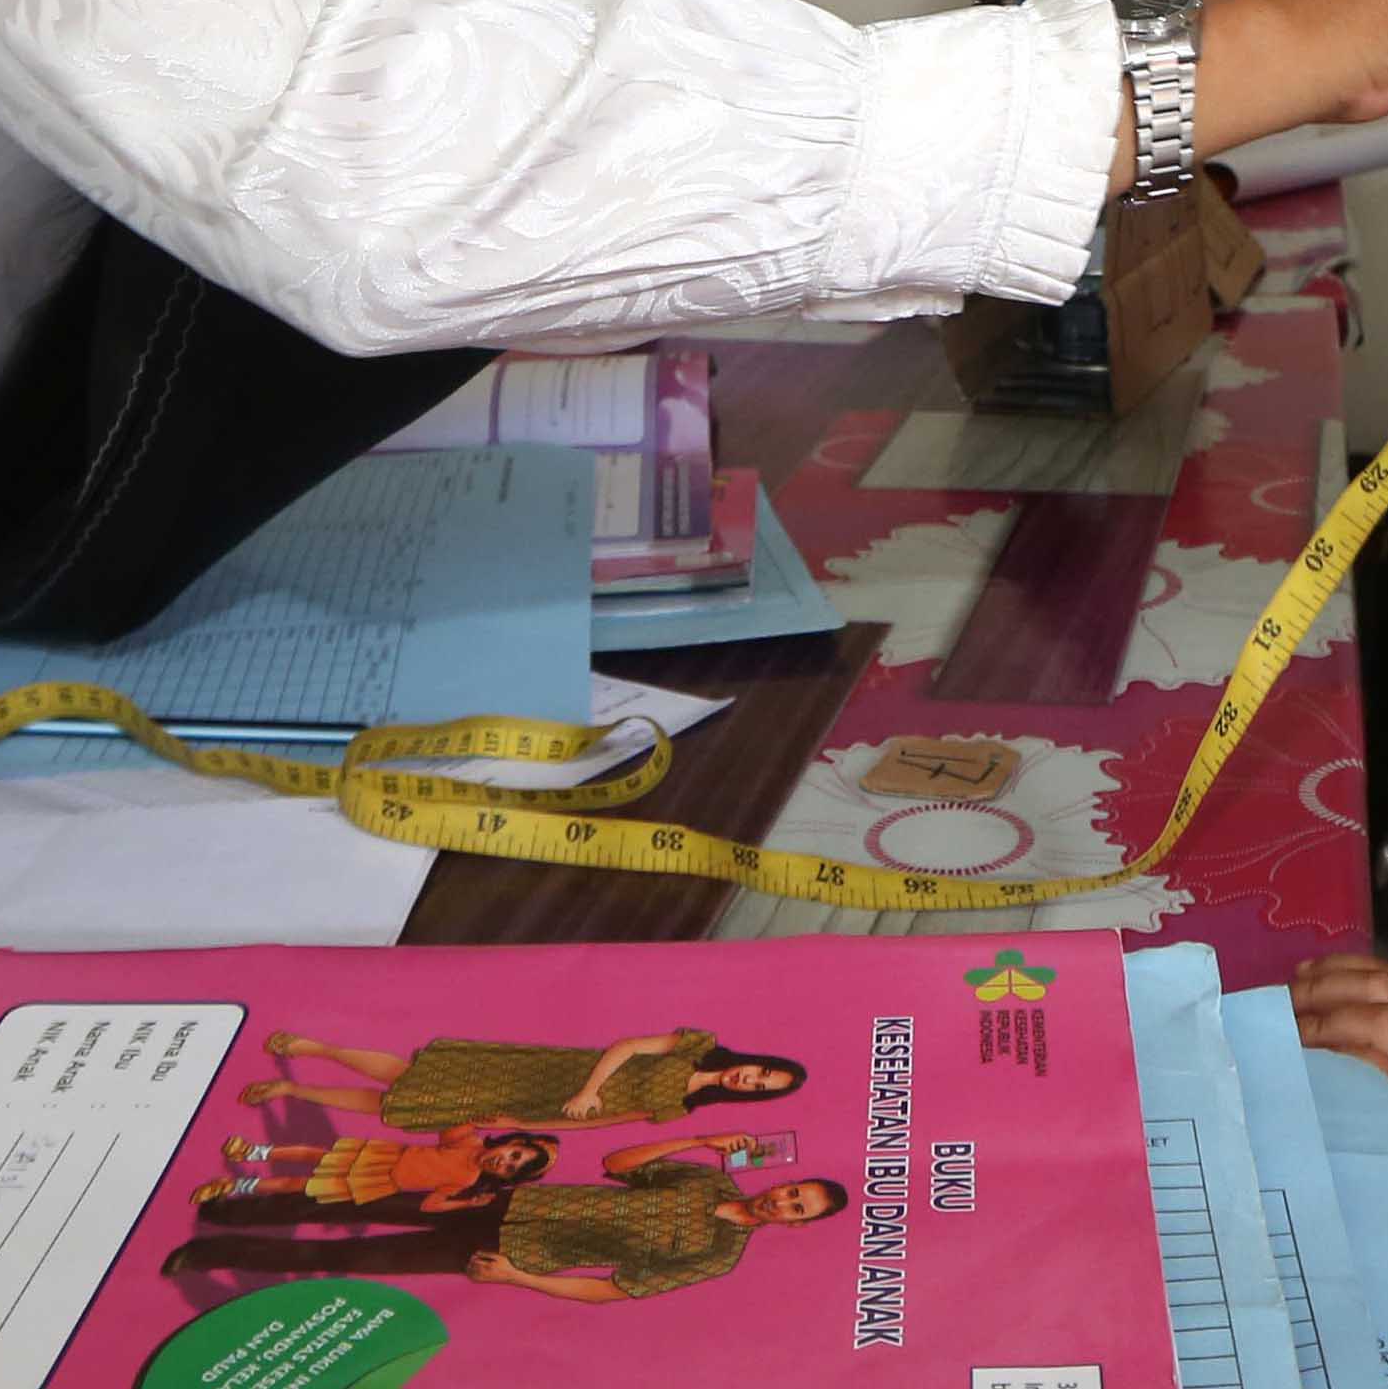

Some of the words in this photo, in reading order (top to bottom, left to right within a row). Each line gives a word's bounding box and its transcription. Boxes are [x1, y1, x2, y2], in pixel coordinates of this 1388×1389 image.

[1305, 536, 1335, 572] 30
[1253, 615, 1283, 653] 31
[1214, 698, 1240, 739] 32
[381, 798, 415, 823] 42
[474, 811, 508, 834] 41
[564, 820, 597, 843] 40
[651, 829, 685, 853] 39
[731, 844, 761, 873] 38
[815, 860, 846, 889] 37
[902, 876, 939, 896] 36
[37, 1020, 68, 1044] NIK
[73, 1020, 111, 1058] Nama
[128, 1020, 158, 1044] NIK
[163, 1020, 199, 1059] Nama
[12, 1046, 49, 1083] Anak
[114, 1048, 142, 1070] Ibu
[150, 1060, 178, 1082] Ibu
[51, 1060, 86, 1093] Anak
[867, 1015, 914, 1152] KESEHATAN
[863, 1155, 910, 1198] IBU
[930, 1141, 975, 1213] BUKU
[859, 1202, 907, 1261] DAN
[853, 1263, 905, 1350] ANAK
[246, 1320, 285, 1350] DAN
[291, 1307, 364, 1363] FASILITAS
[348, 1307, 395, 1341] BAWA
[201, 1348, 249, 1383] PAUD
[308, 1340, 353, 1376] BUKU
